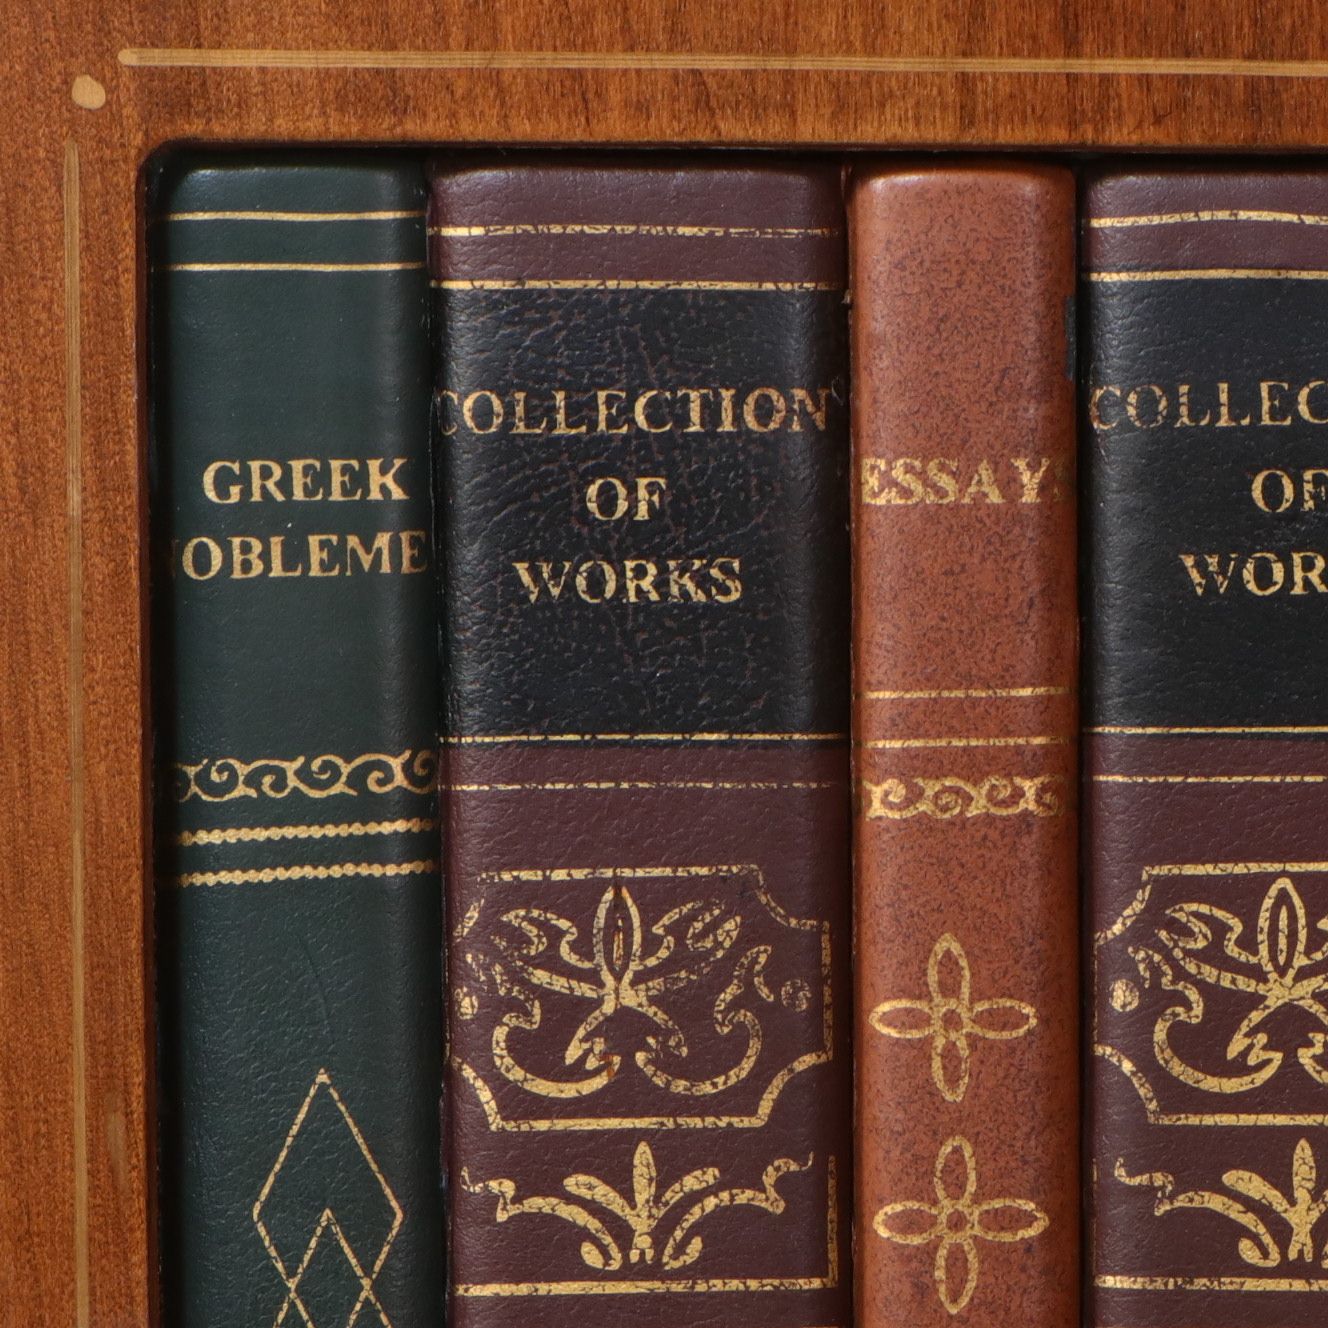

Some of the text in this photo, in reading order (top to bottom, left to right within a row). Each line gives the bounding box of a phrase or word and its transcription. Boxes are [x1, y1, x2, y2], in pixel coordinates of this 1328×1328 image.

[436, 386, 832, 437] COLLECTION
[203, 457, 409, 504] GREEK
[586, 477, 666, 520] OF
[861, 456, 1062, 505] ESSAY
[173, 530, 428, 581] OBLEME
[512, 557, 742, 604] WORKS
